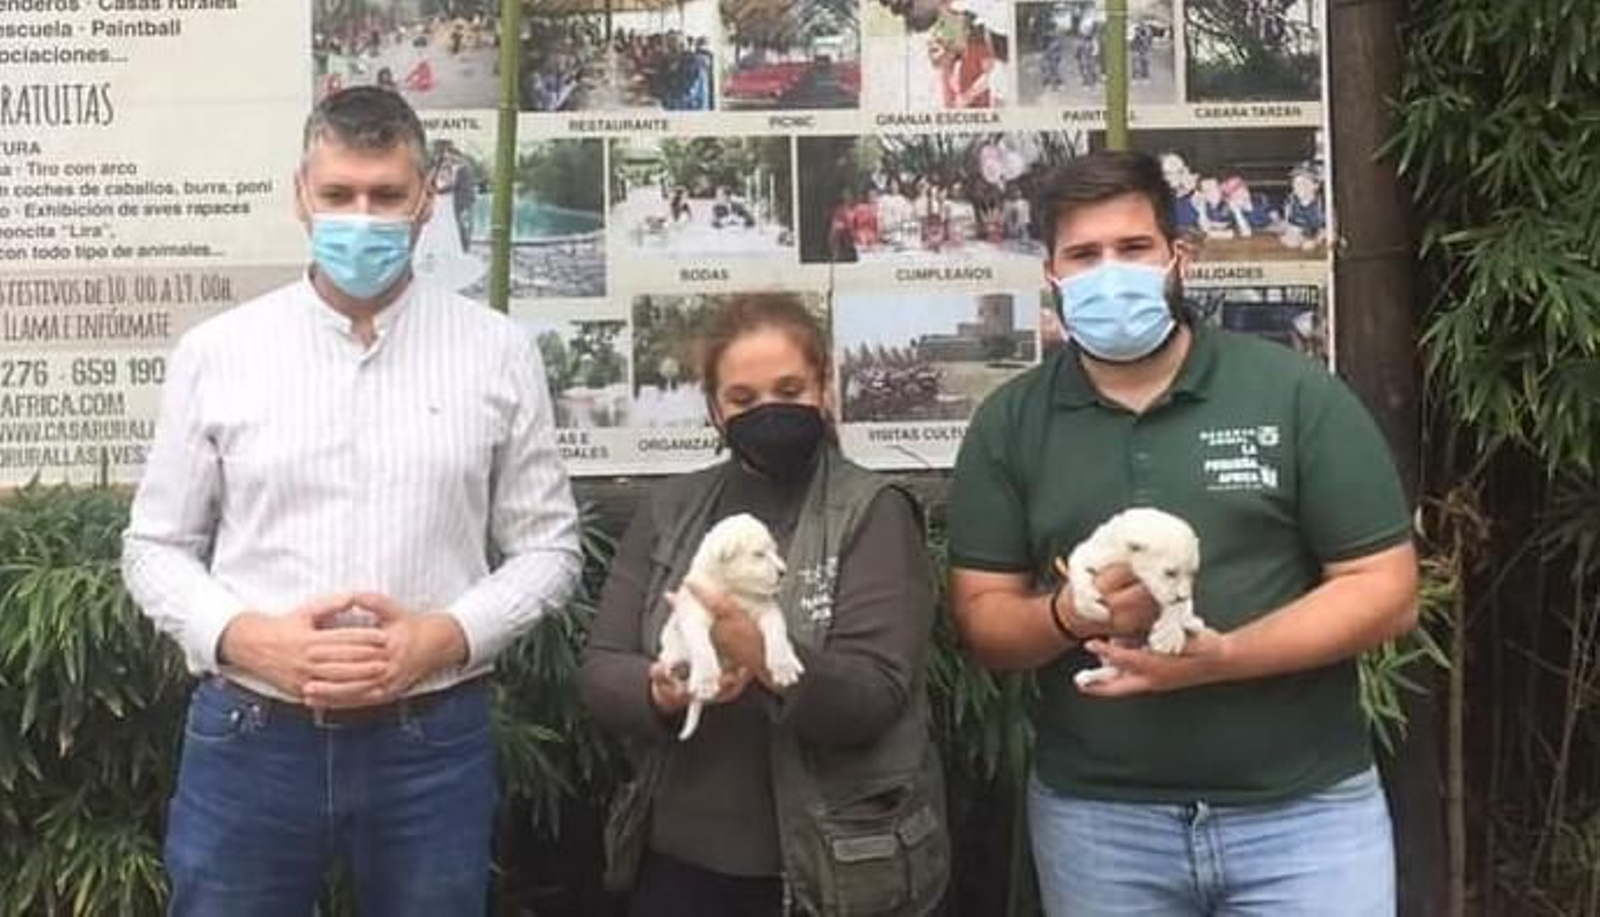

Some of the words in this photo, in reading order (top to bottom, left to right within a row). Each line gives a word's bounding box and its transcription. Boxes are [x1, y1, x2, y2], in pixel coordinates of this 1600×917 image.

[91, 19, 181, 37] Paintball
[1, 82, 114, 126] RATUITAS
[568, 118, 668, 132] RESTAURANTE
[935, 111, 1000, 125] ESCUELA
[26, 161, 59, 177] Tiro
[63, 164, 96, 177] con
[100, 163, 137, 176] arco
[13, 183, 74, 198] coches
[79, 182, 100, 197] de
[236, 180, 272, 197] poni
[24, 202, 114, 218] Exhibición
[118, 202, 138, 217] de
[143, 204, 182, 217] aves
[186, 203, 250, 218] rapaces
[32, 246, 71, 260] todo
[75, 244, 108, 260] tipo
[112, 244, 133, 259] de
[680, 267, 730, 281] BODAS
[4, 311, 59, 342] LLAMA
[1, 359, 48, 387] 276
[72, 358, 117, 386] 659
[128, 356, 166, 384] 190
